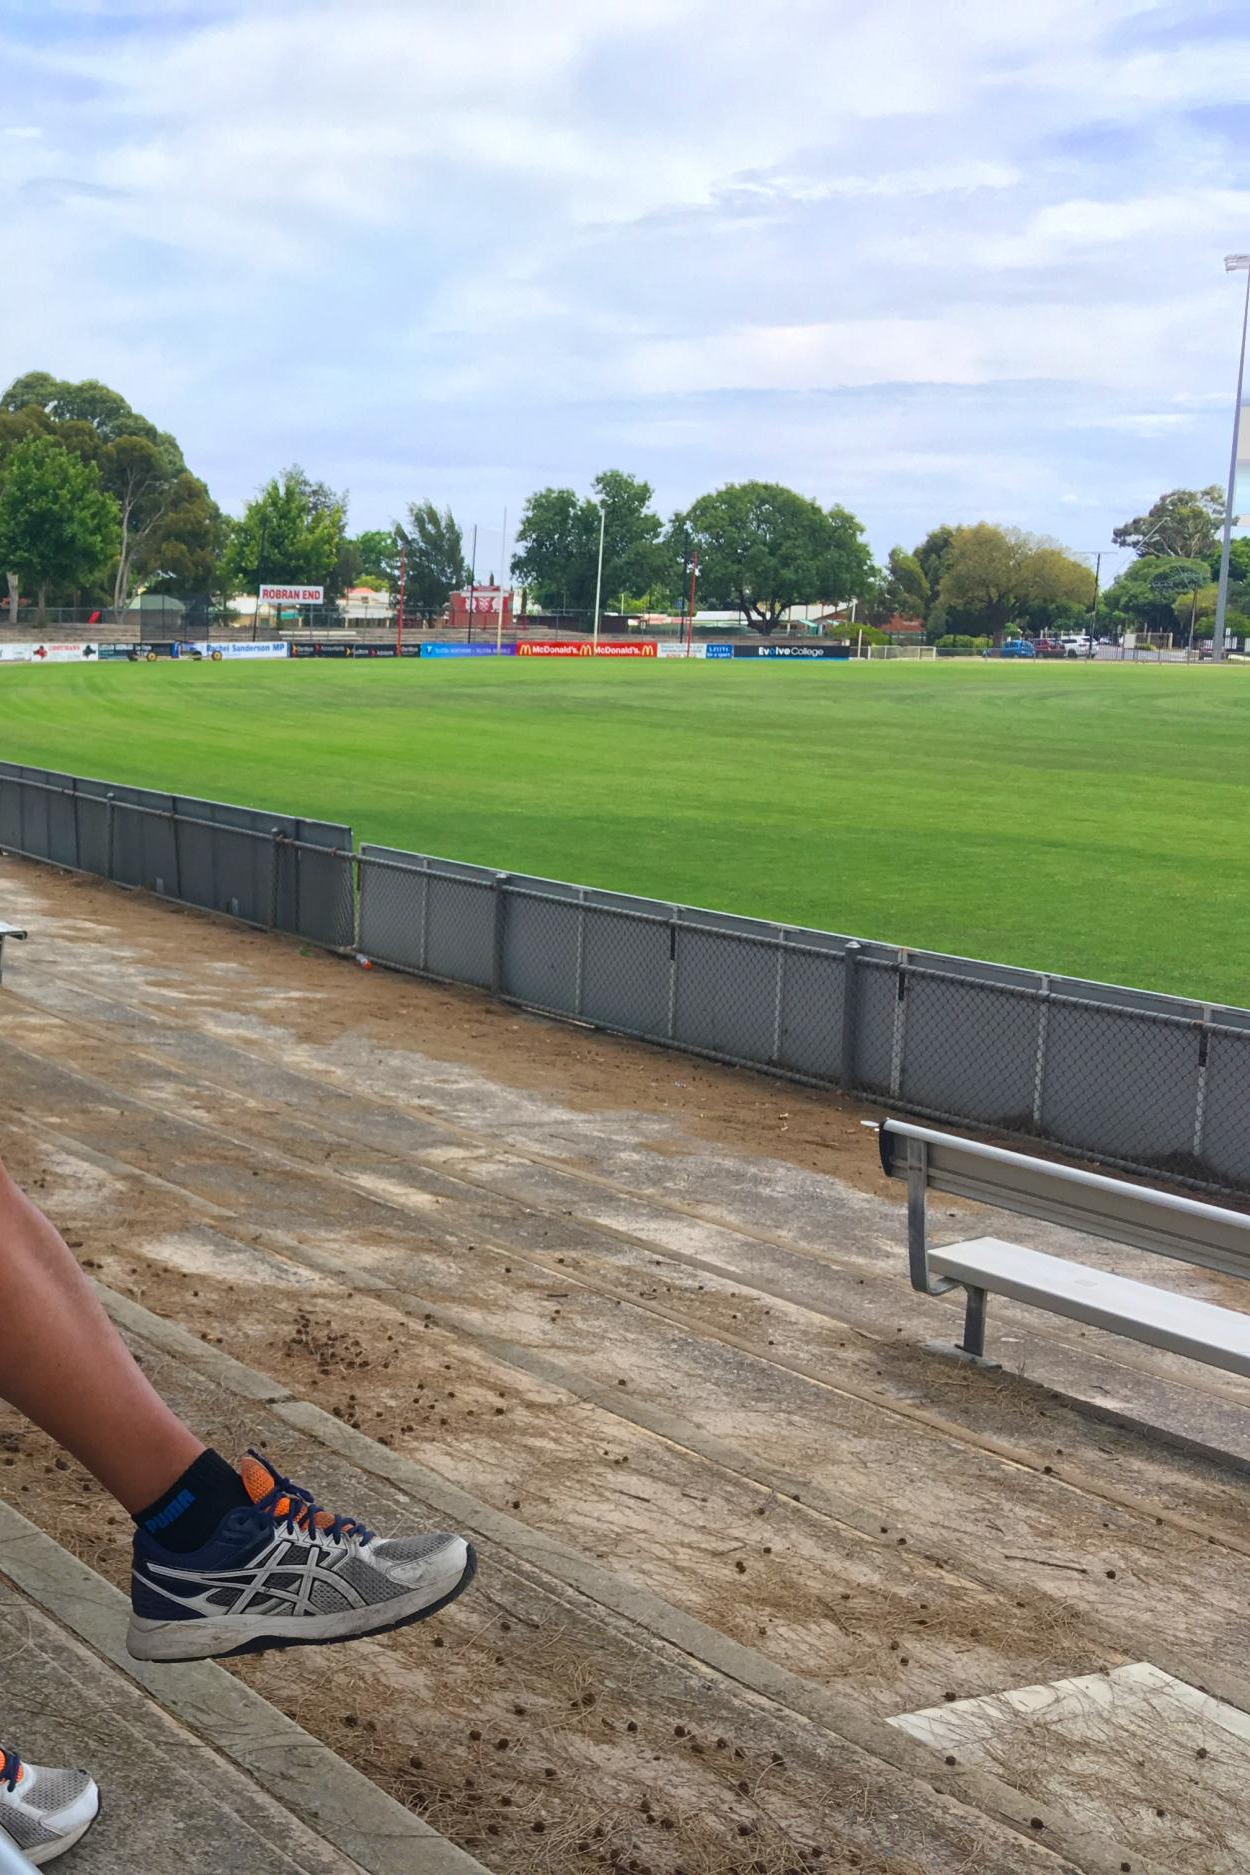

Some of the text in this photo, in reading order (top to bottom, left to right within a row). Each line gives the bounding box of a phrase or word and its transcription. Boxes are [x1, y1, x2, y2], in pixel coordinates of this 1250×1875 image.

[262, 589, 320, 600] ROBRAN END
[232, 644, 271, 652] Sanderson
[272, 643, 284, 651] MP
